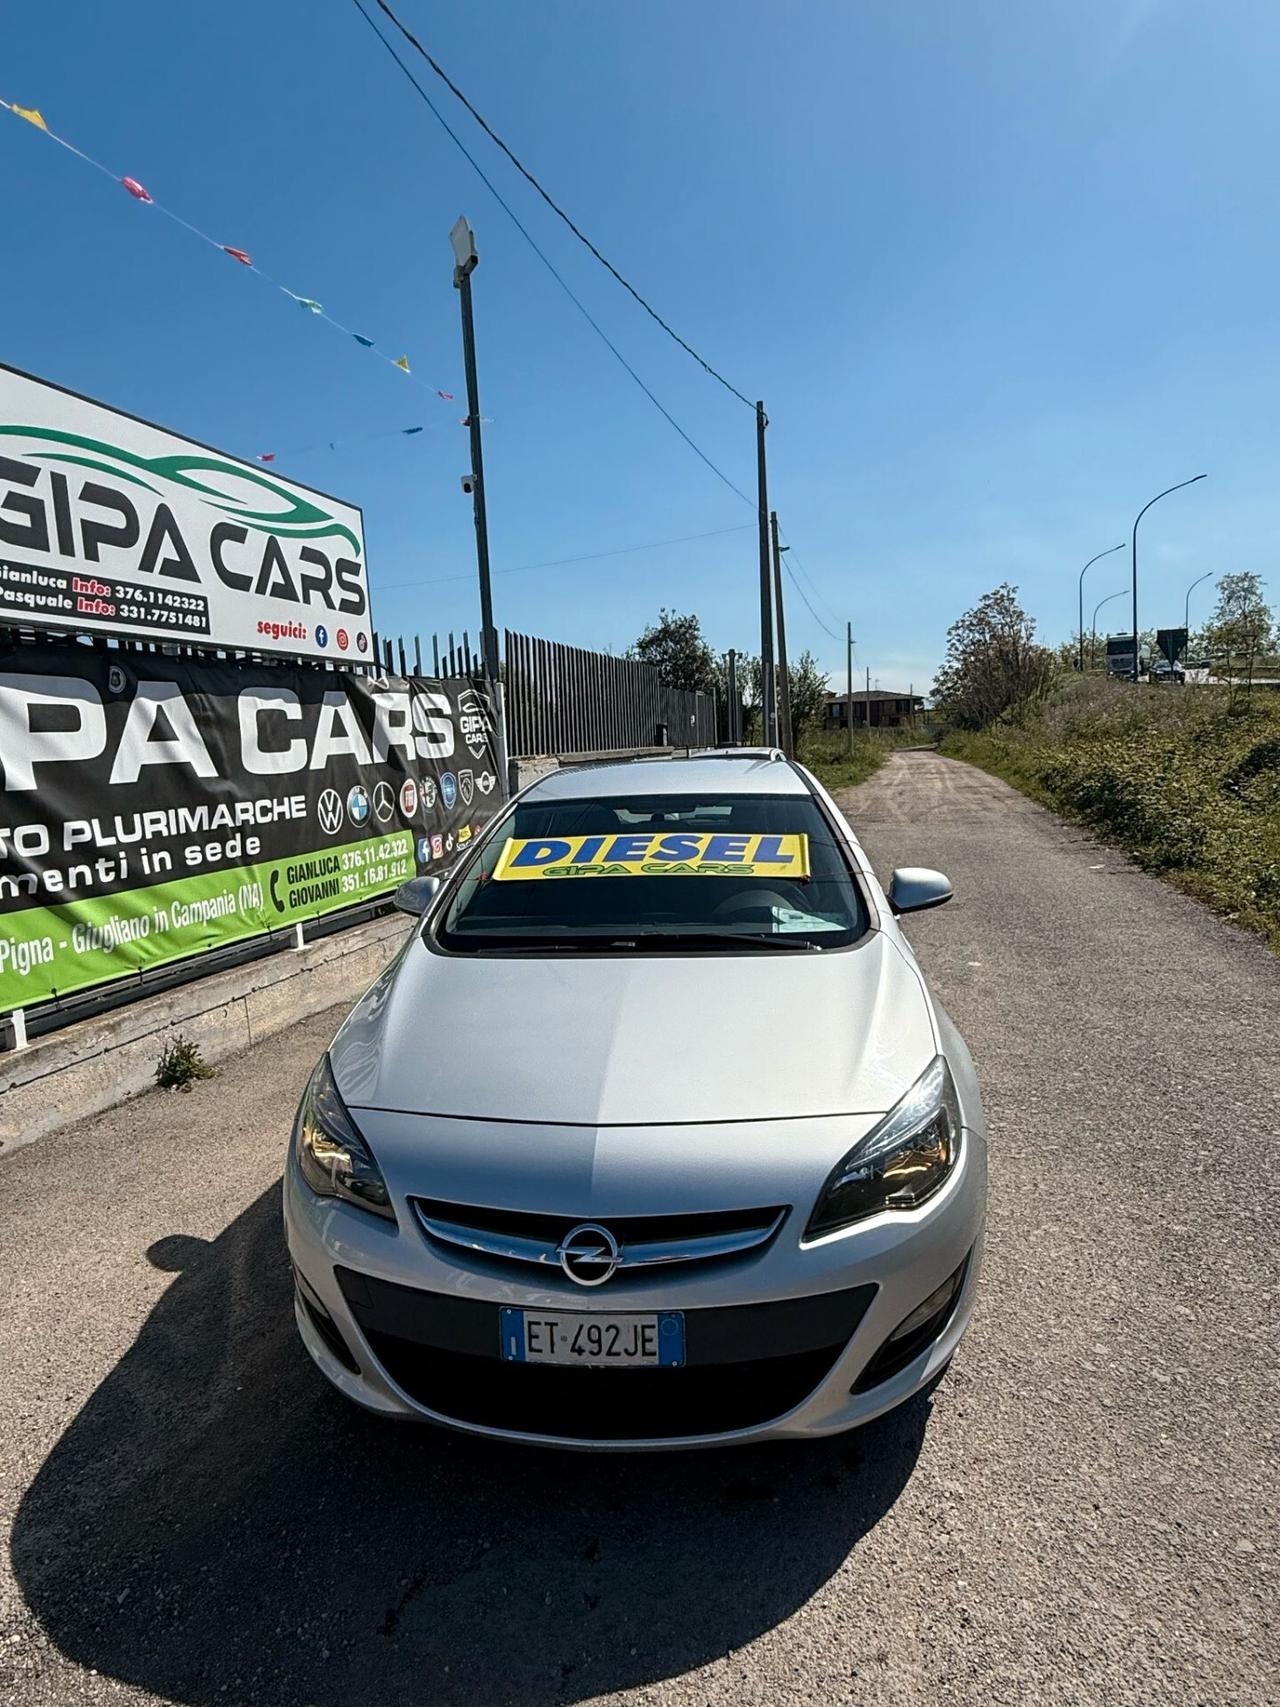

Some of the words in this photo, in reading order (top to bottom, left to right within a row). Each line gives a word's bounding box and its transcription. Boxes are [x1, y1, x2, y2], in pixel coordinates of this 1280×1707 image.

[0, 455, 201, 583] GIPA
[209, 521, 366, 616] CARS
[0, 565, 67, 590] ianluca
[72, 576, 111, 597] Info:
[115, 586, 205, 611] 376.1142322
[77, 597, 116, 616] Info:
[120, 605, 206, 628] 331.7751481
[257, 619, 307, 640] seguici:
[238, 686, 454, 775] CARS
[63, 795, 307, 851] PLURIMARCHE
[140, 848, 172, 875] in
[184, 833, 261, 866] sede
[287, 855, 341, 885] GIANLUCA
[342, 838, 408, 870] 376.11.42.322
[511, 835, 795, 867] DIESEL
[543, 864, 631, 876] GIPA
[641, 863, 754, 874] CARS
[289, 878, 340, 908] GIOVANNI
[342, 859, 407, 893] 351.16.81.912
[72, 914, 150, 953] Giugliano
[152, 906, 169, 933] in
[171, 889, 236, 928] Campania
[239, 882, 264, 916] (NA)
[527, 1320, 558, 1354] ET
[569, 1323, 657, 1357] 492JE
